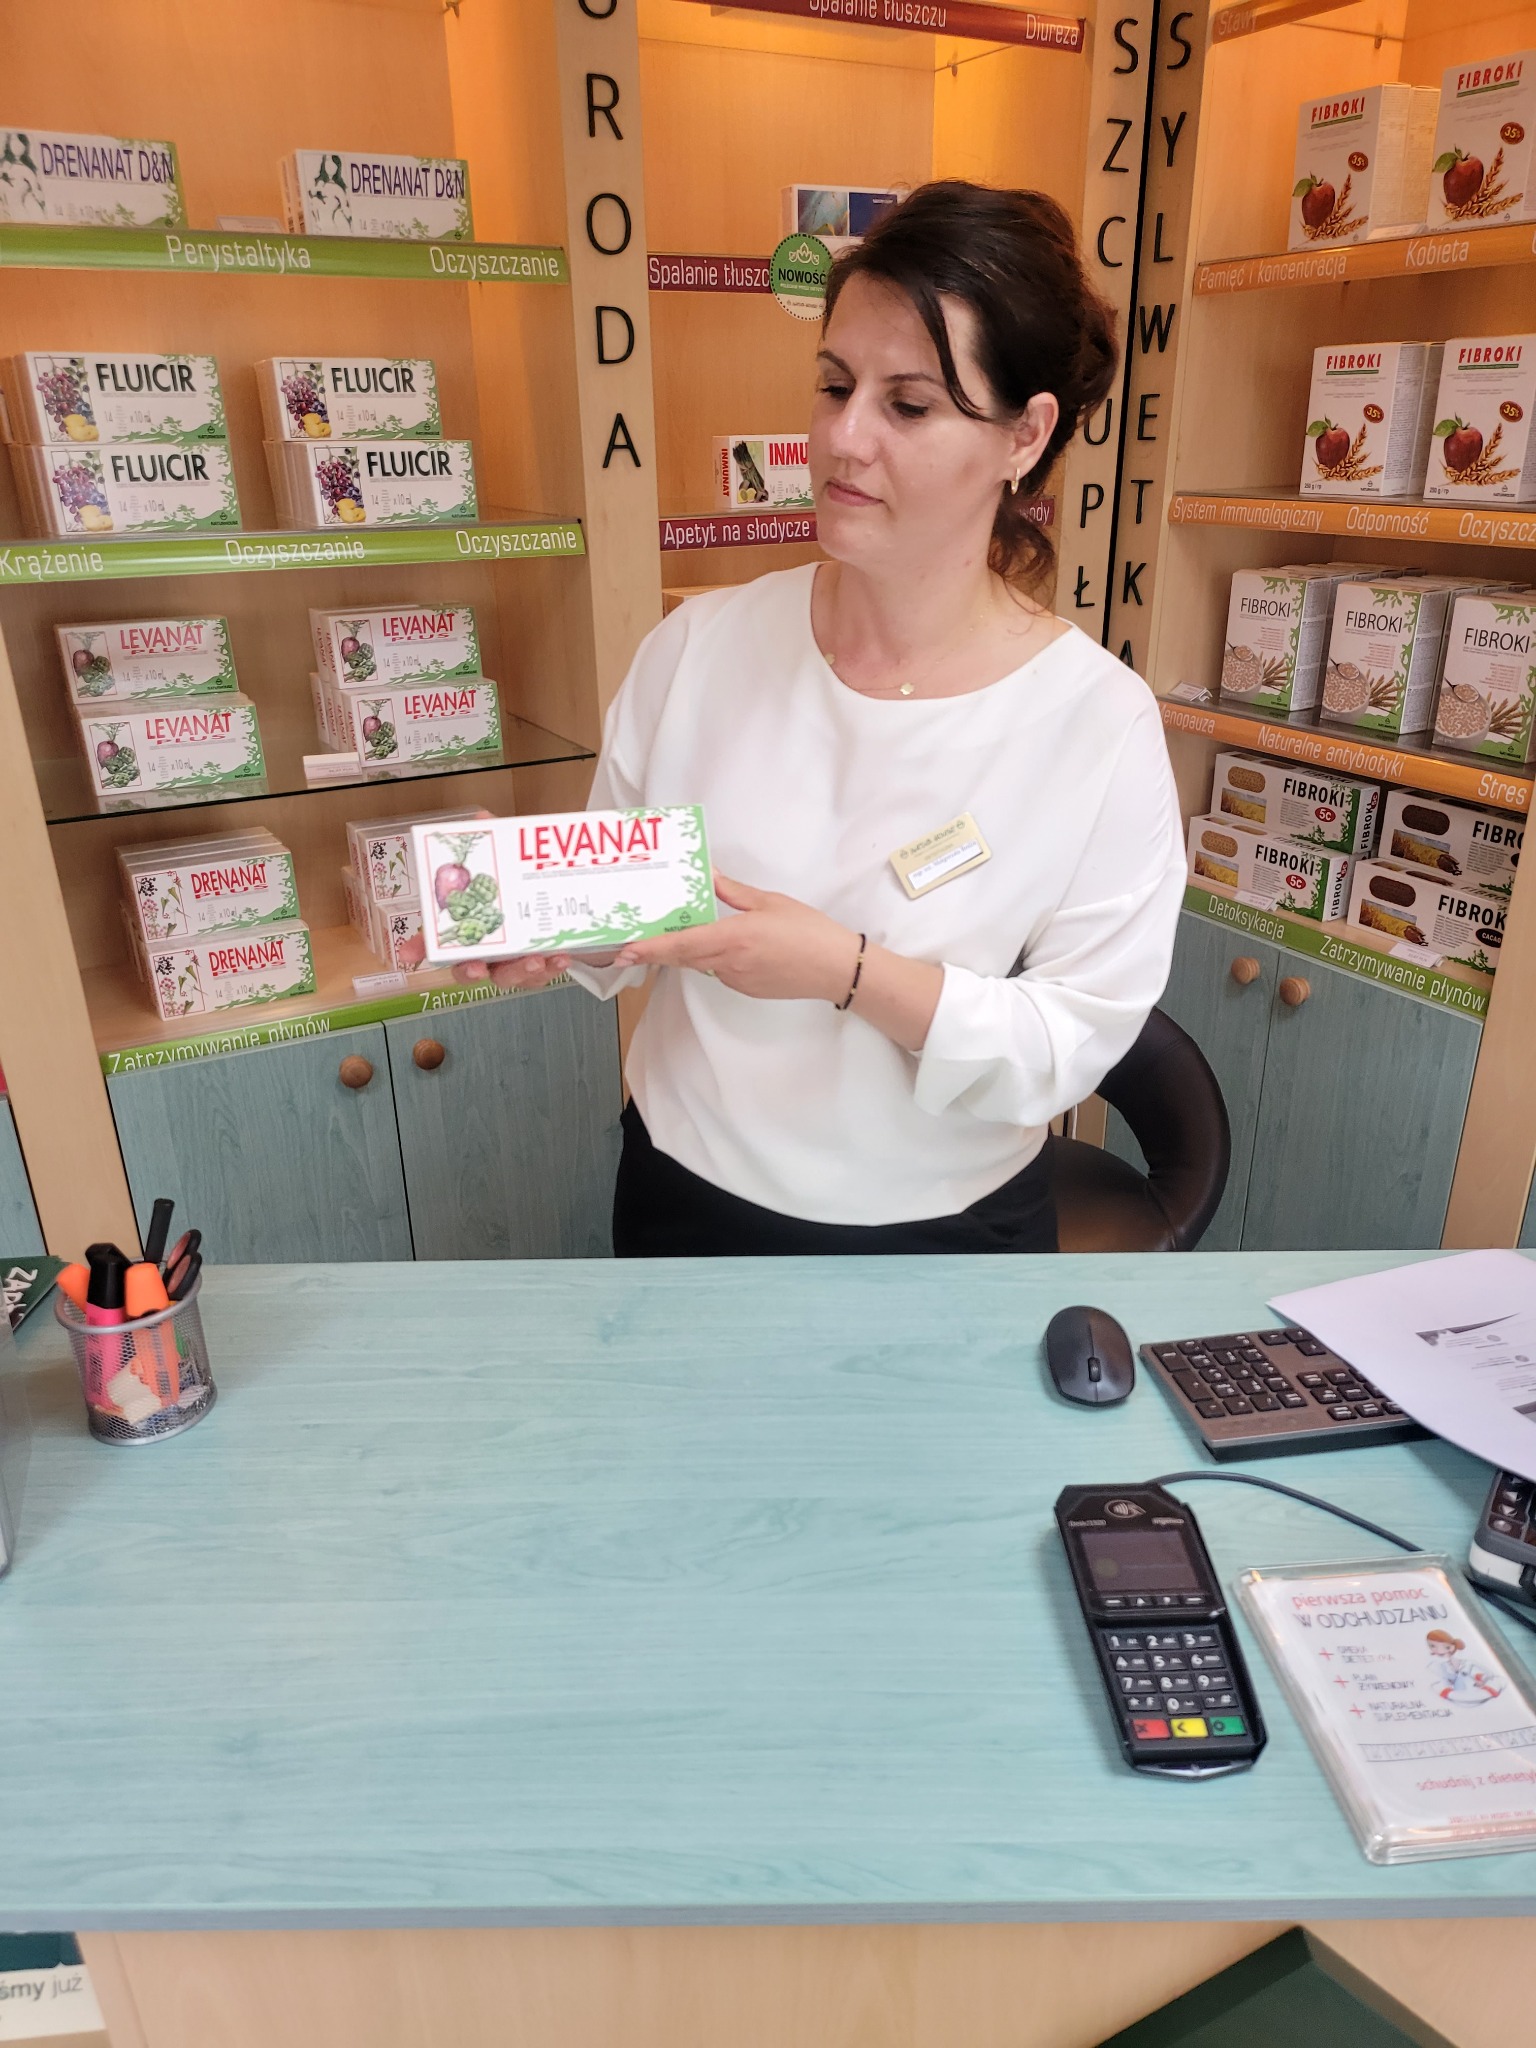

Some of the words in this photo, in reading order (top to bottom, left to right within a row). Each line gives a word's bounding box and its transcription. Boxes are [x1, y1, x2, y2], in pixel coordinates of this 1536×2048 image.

[884, 0, 946, 27] tłuszczu
[1218, 10, 1257, 35] Stawy
[1026, 14, 1079, 46] Diureza
[1457, 60, 1523, 91] FIBROKI
[1311, 97, 1365, 123] FIBROKI
[40, 143, 134, 182] DRENANAT
[139, 150, 174, 184] D&N
[351, 163, 431, 198] DRENANAT
[436, 168, 465, 199] D&N
[578, 0, 641, 468] RODA
[166, 235, 311, 274] Perystaltyka
[430, 246, 559, 280] Oczyszczanie
[1405, 240, 1469, 267] Kobieta
[649, 257, 718, 289] Spalanie
[724, 260, 770, 287] tłuszc
[778, 268, 827, 285] NOWOŚĆ
[1199, 263, 1245, 292] Pamięć
[1257, 255, 1347, 283] koncentracja
[1074, 18, 1139, 608] SZCUPŁ
[1326, 353, 1381, 370] FIBROKI
[1458, 345, 1523, 364] FIBROKI
[95, 363, 197, 392] FLUICIR
[331, 366, 416, 393] FLUICIR
[110, 454, 210, 482] FLUICIR
[367, 450, 452, 477] FLUICIR
[769, 442, 809, 466] INMU
[721, 448, 730, 497] INMUNAT
[1173, 499, 1216, 520] System
[1220, 500, 1323, 530] immunologiczny
[1347, 506, 1429, 535] Odporność
[455, 526, 577, 558] Oczyszczanie
[664, 521, 716, 549] Apetyt
[723, 525, 740, 541] na
[747, 516, 810, 543] słodycze
[0, 546, 104, 580] Krążenie
[225, 536, 365, 568] Oczyszczanie
[1240, 597, 1291, 618] FIBROKI
[383, 613, 454, 637] LEVANAT
[1346, 610, 1402, 634] FIBROKI
[119, 625, 203, 650] LEVANAT
[131, 646, 198, 655] PLUS
[391, 632, 450, 641] PLUS
[1464, 627, 1531, 654] FIBROKI
[405, 689, 476, 715] LEVANAT
[413, 710, 471, 719] PLUS
[146, 713, 232, 740] LEVANAT
[156, 734, 225, 745] PLUS
[1257, 725, 1322, 758] Naturalne
[1326, 746, 1407, 779] antybiotyki
[1284, 777, 1345, 808] FIBROKI
[1478, 773, 1527, 805] Stres
[518, 817, 662, 861] LEVANAT
[1361, 802, 1373, 850] FIBROKI
[536, 853, 651, 870] PLUS
[1255, 844, 1315, 876] FIBROKI
[190, 863, 266, 894] DRENANAT
[195, 883, 269, 899] PLUS
[1331, 872, 1343, 917] FIBROKI
[517, 900, 530, 920] 14
[1208, 894, 1285, 939] Detoksykacja
[1437, 894, 1507, 931] FIBROK
[208, 940, 284, 972] DRENANAT
[212, 960, 286, 977] PLUS
[1319, 935, 1425, 990] Zatrzymywanie
[1429, 977, 1486, 1012] płynów
[108, 1027, 260, 1074] Zatrzymywanie
[268, 1015, 331, 1043] płynów
[1292, 1592, 1367, 1610] pierwsza
[1371, 1587, 1428, 1605] pomoc
[1111, 1635, 1120, 1647] 1
[1146, 1635, 1159, 1646] 2
[1184, 1633, 1196, 1645] 3
[1116, 1656, 1128, 1667] 4
[1153, 1655, 1165, 1667] 5
[1191, 1654, 1203, 1665] 6
[1123, 1677, 1133, 1689] 7
[1161, 1676, 1173, 1688] 8
[1198, 1675, 1210, 1687] 9
[1167, 1697, 1180, 1710] 0
